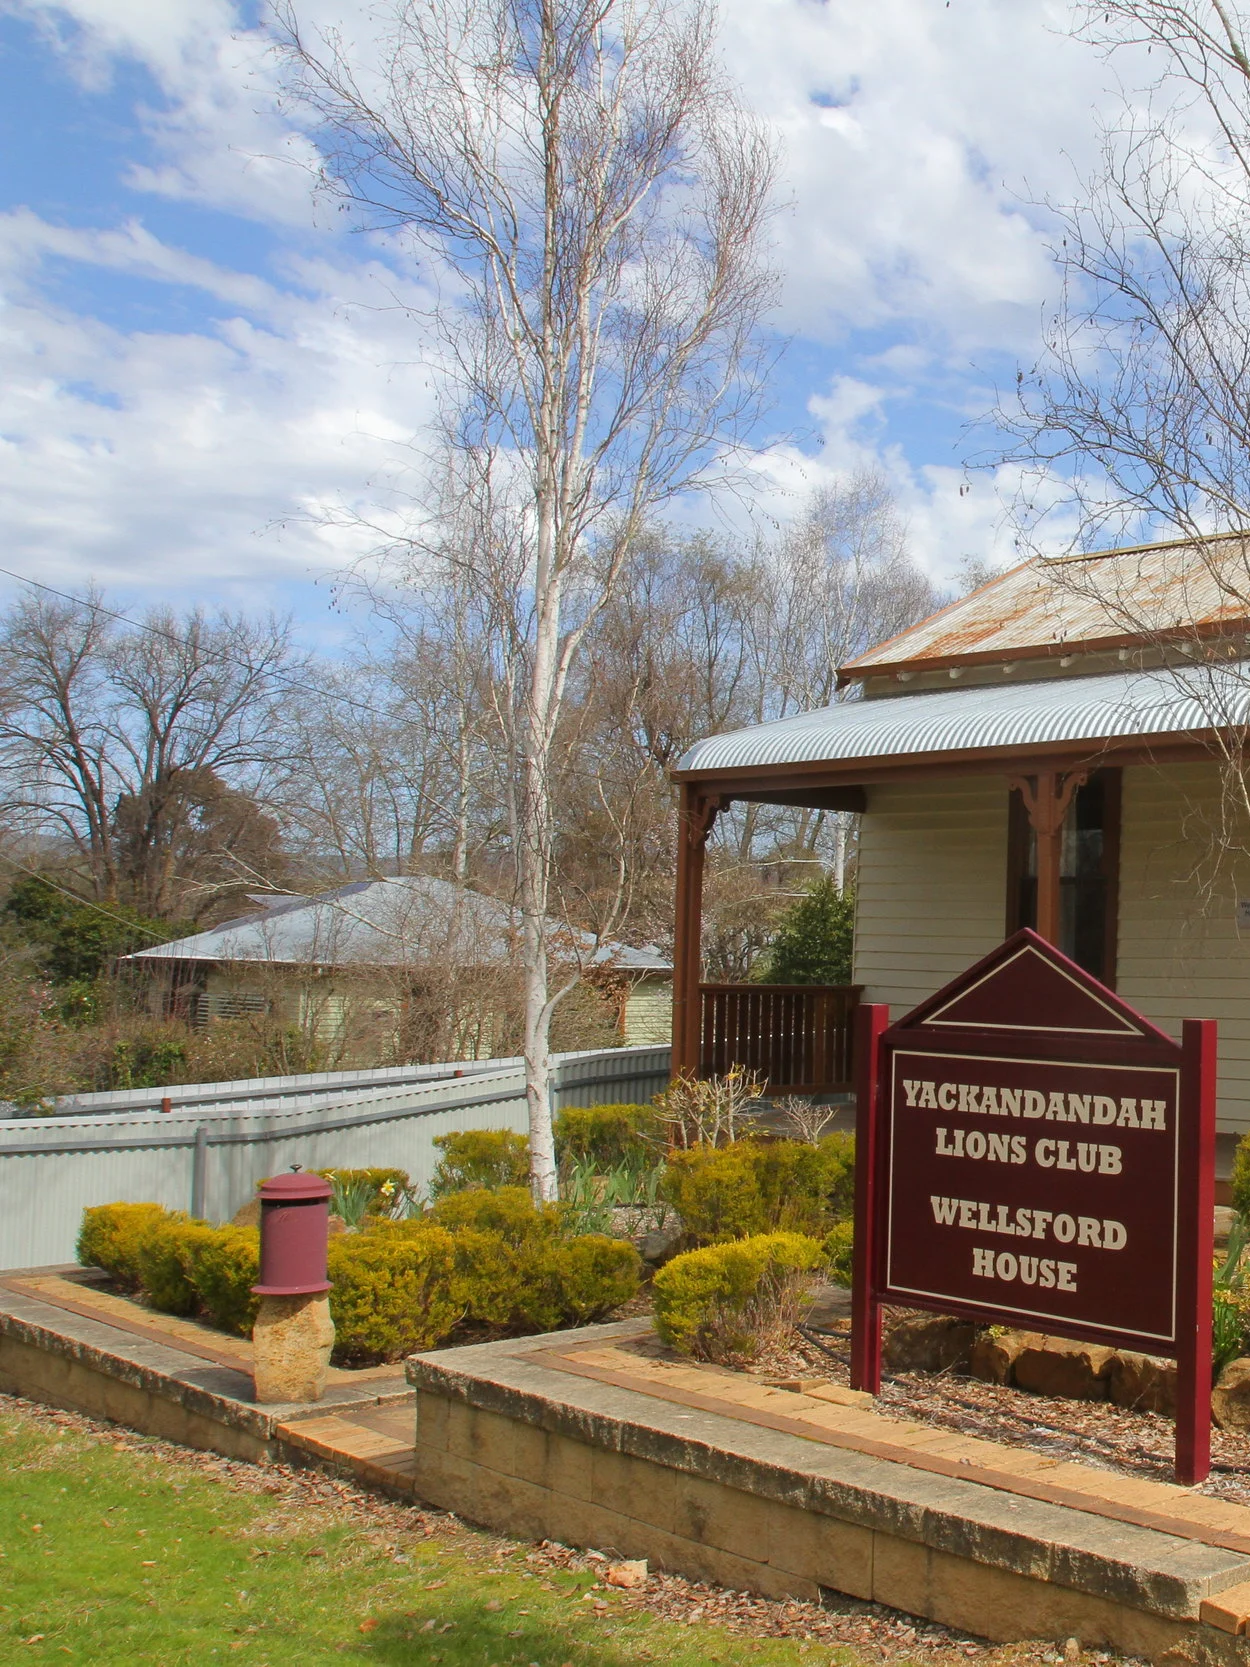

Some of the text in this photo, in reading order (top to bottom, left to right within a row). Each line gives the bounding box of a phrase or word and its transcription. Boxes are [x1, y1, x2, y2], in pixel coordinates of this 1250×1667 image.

[902, 1079, 1167, 1131] YACKANDANDAH
[935, 1127, 1123, 1175] LIONS CLUB
[930, 1195, 1128, 1251] WELLSFORD
[972, 1247, 1078, 1293] HOUSE
